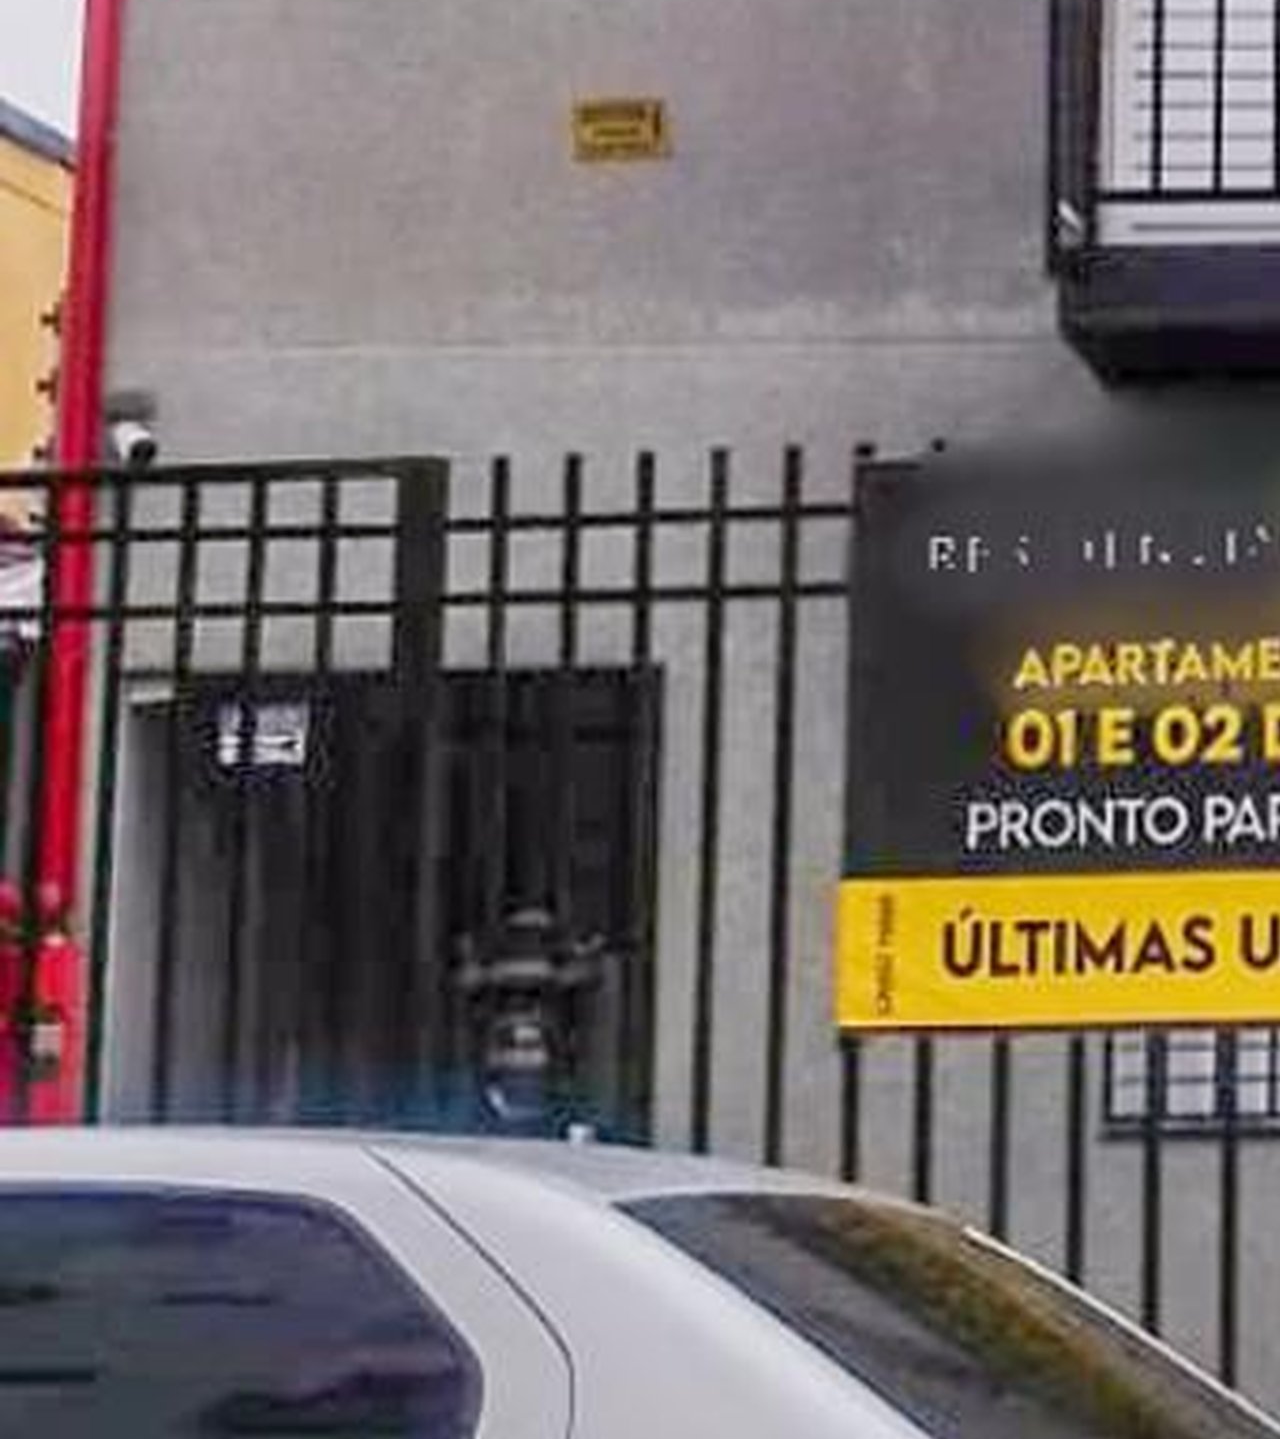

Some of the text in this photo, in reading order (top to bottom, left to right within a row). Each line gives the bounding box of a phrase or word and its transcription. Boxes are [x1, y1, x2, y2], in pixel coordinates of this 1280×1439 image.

[1007, 712, 1074, 769] 01
[1100, 710, 1133, 764] E
[1154, 707, 1243, 763] 02
[966, 796, 1188, 849] PRONTO
[942, 908, 1214, 977] ÚLTIMAS
